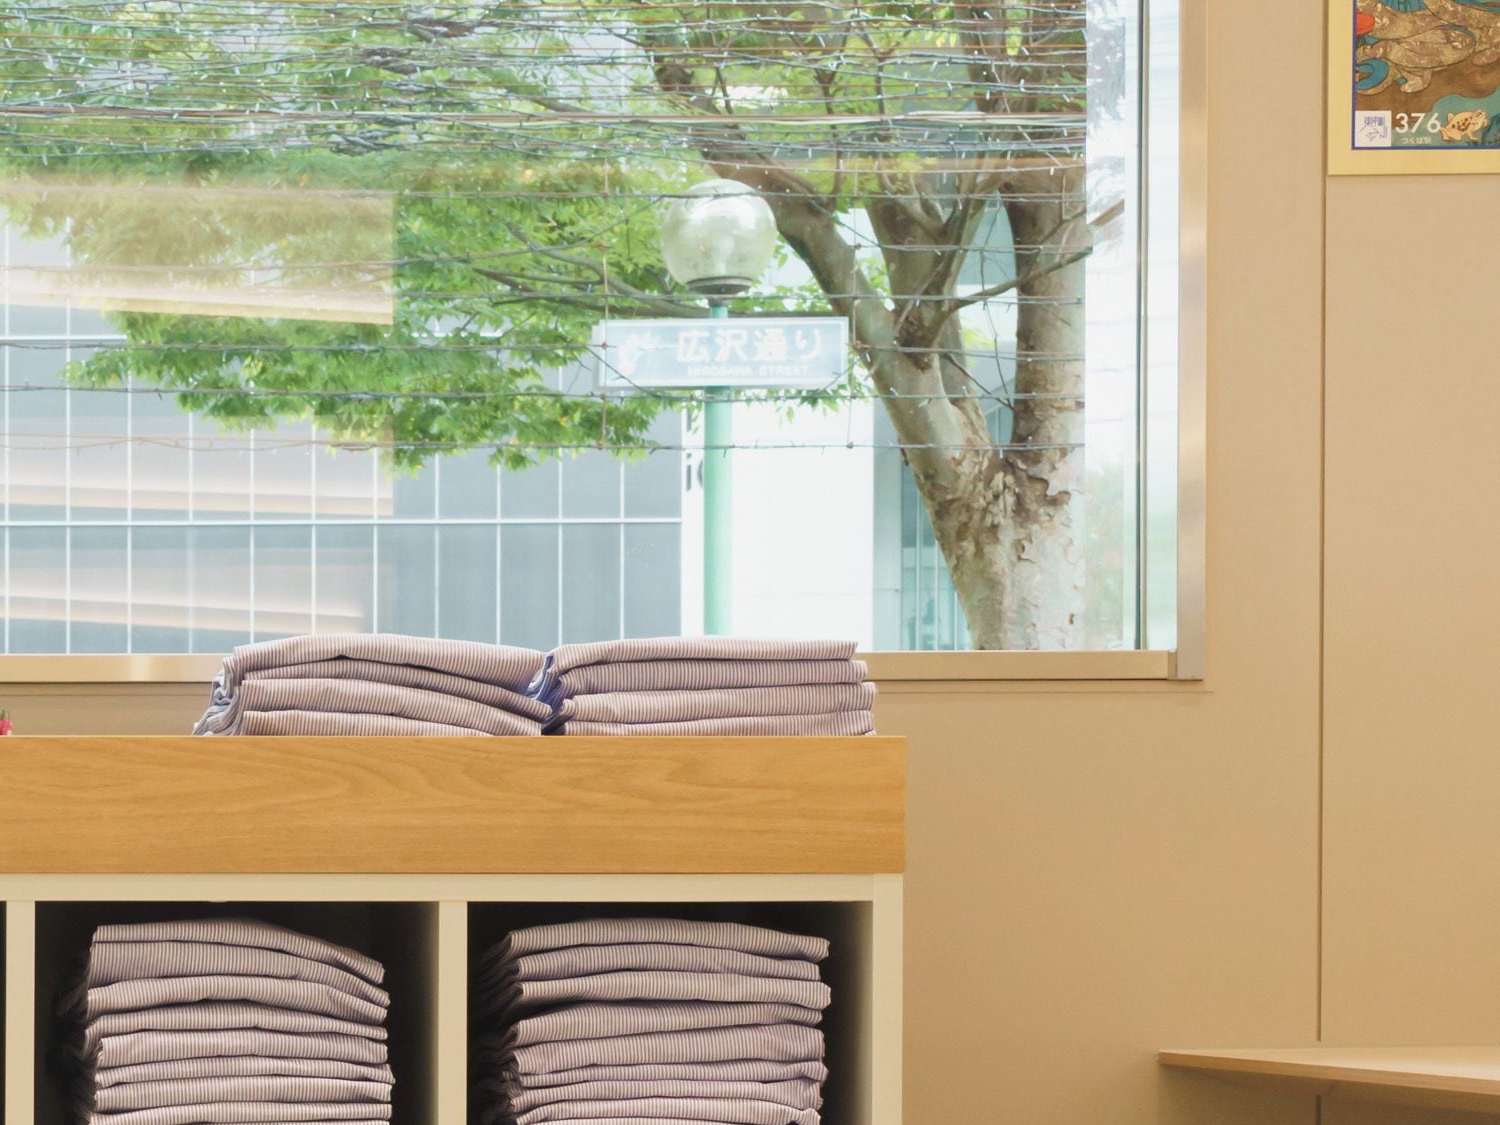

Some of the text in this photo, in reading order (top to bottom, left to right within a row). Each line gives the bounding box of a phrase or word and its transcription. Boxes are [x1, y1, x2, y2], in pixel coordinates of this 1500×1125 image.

[1395, 112, 1441, 133] 376
[676, 328, 821, 363] 広沢通り
[687, 365, 809, 377] HIROSAWA STREET
